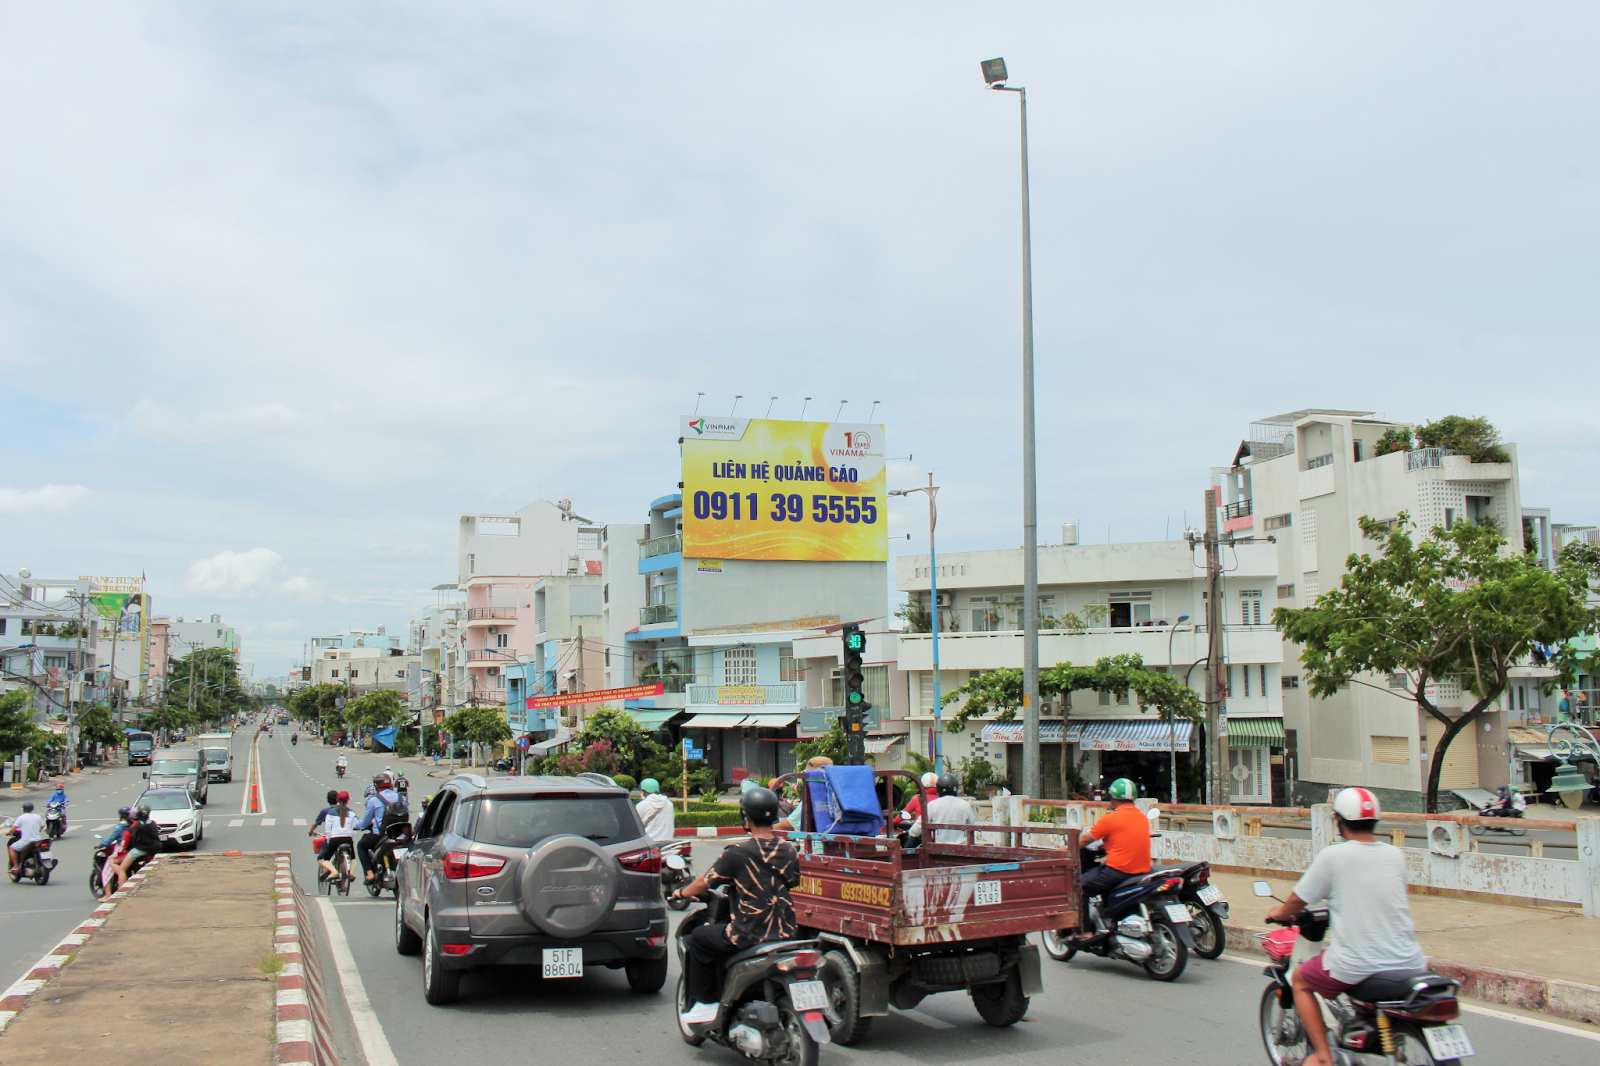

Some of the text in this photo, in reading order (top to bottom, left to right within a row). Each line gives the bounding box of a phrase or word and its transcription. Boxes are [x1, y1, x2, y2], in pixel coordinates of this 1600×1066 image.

[829, 448, 864, 456] VINAMA
[713, 459, 858, 484] LIÊN HỆ QUẢNG CÁO
[693, 490, 877, 524] 0911 39 5555
[841, 883, 890, 906] 0937319842
[552, 950, 573, 963] 51F
[544, 963, 581, 977] 886.04
